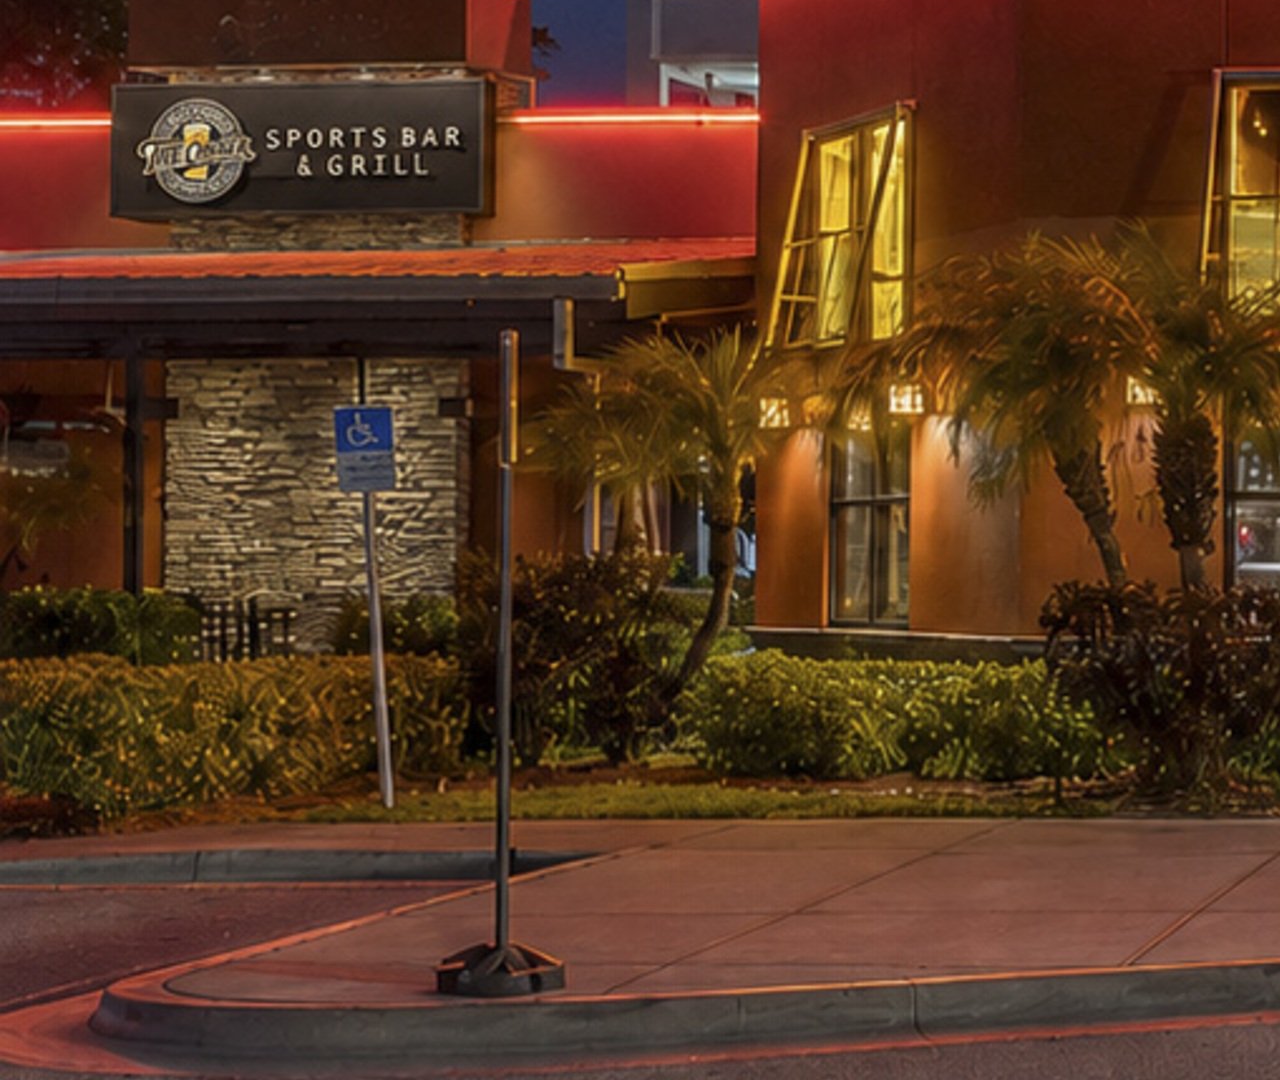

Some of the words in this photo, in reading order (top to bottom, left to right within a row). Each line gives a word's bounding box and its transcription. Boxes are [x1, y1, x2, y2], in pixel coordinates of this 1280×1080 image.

[266, 126, 389, 150] SPORTS
[401, 126, 461, 148] BAR
[297, 154, 314, 176] &
[327, 153, 430, 176] GRILL
